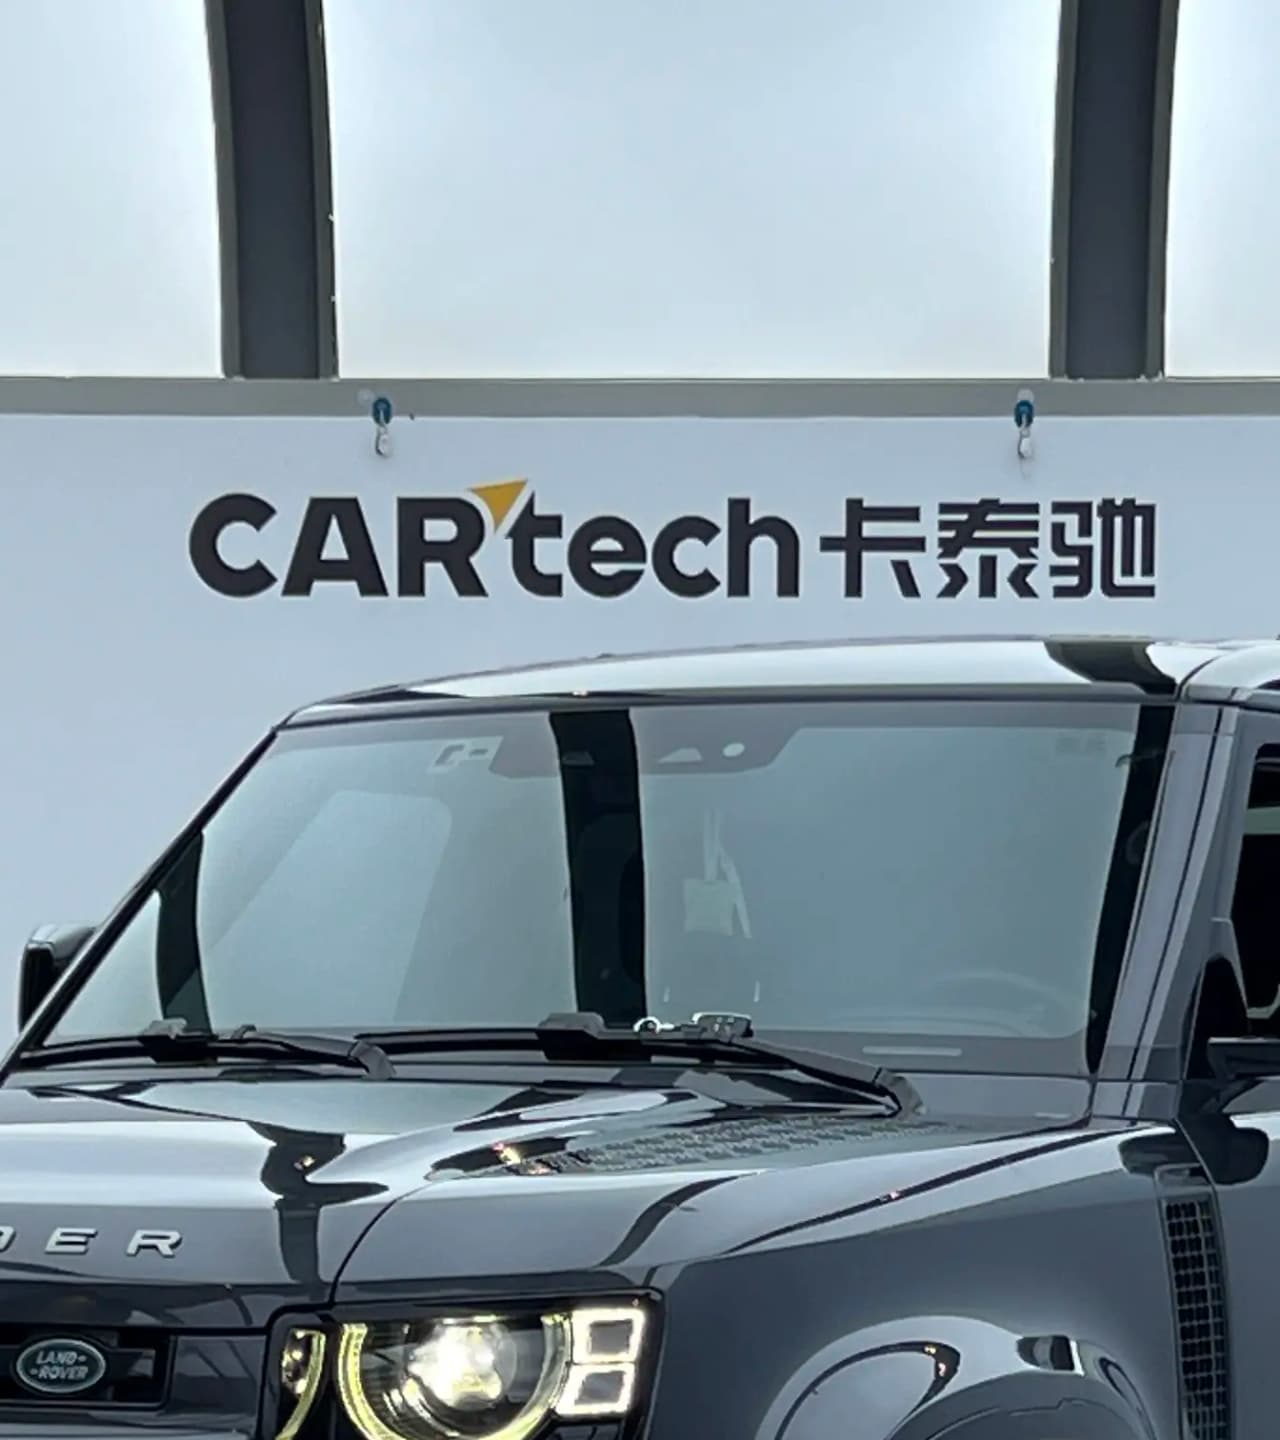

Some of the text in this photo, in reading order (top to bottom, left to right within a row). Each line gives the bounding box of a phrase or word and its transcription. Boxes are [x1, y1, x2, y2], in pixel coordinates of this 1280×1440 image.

[188, 491, 1157, 601] CARtech 卡泰驰
[35, 1350, 78, 1366] LAND
[37, 1366, 90, 1381] ROVER
